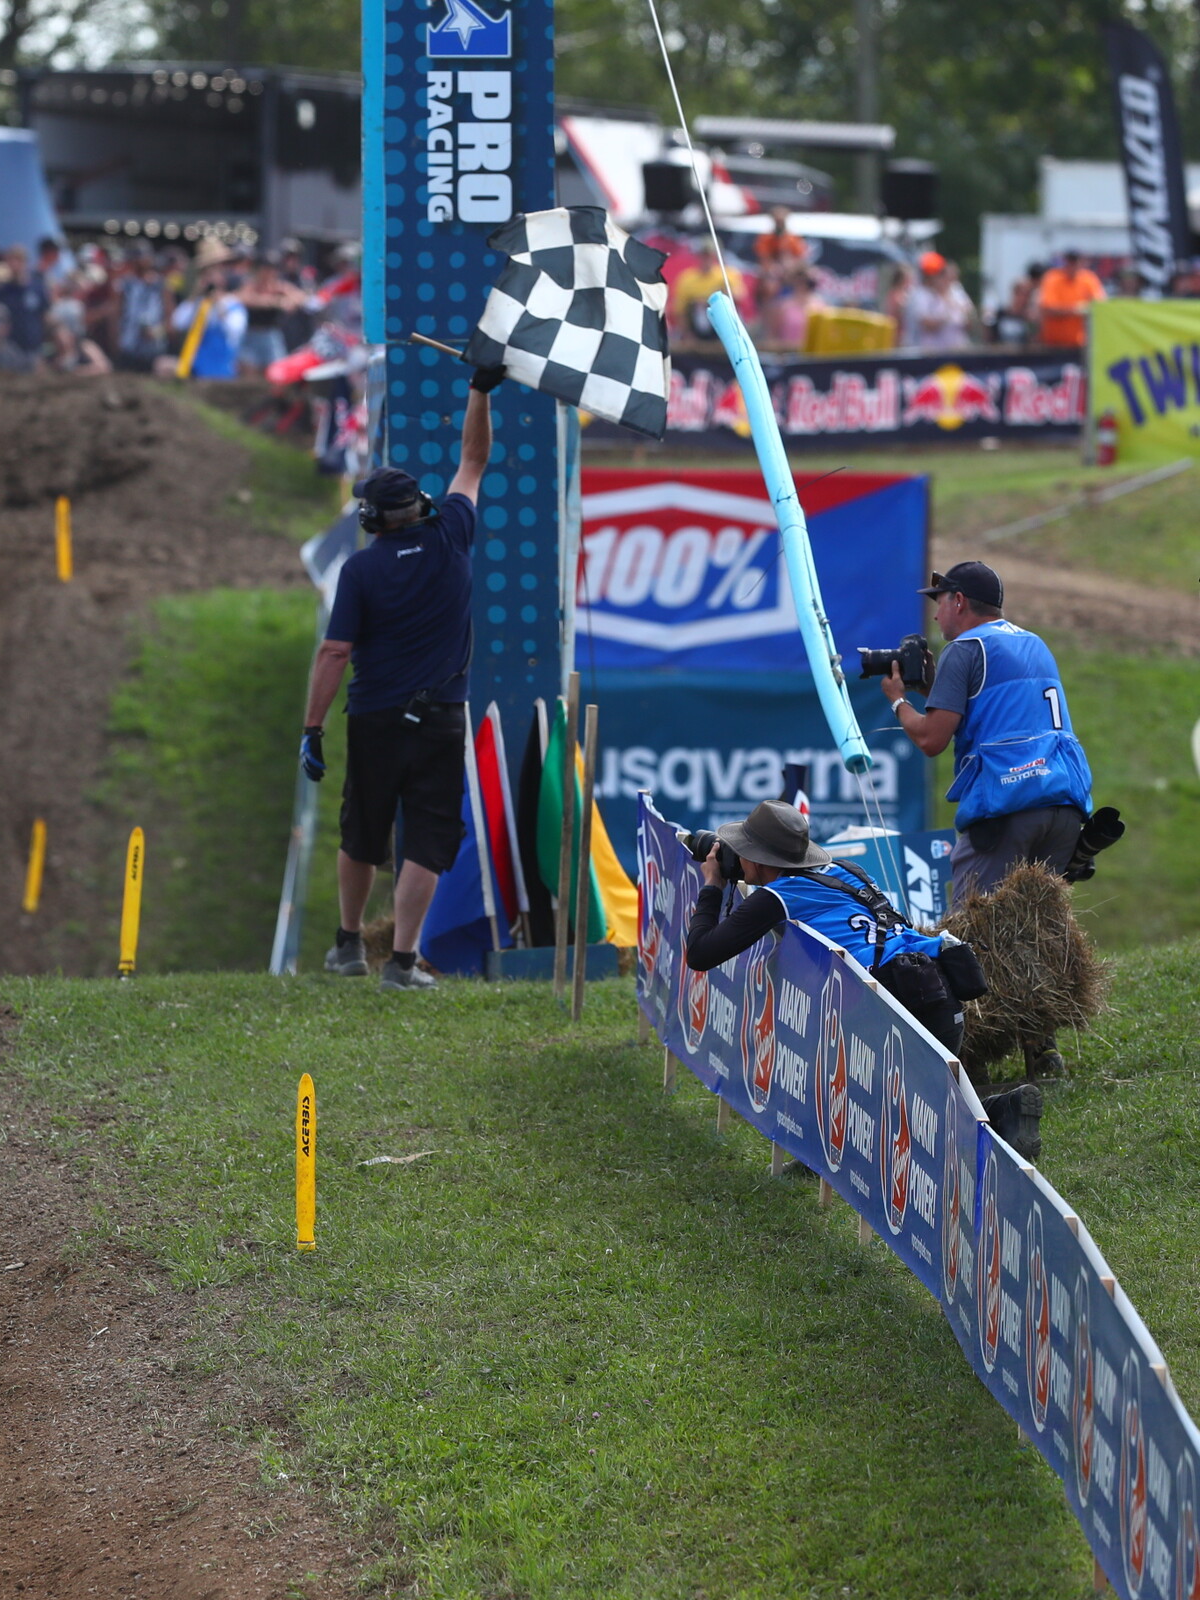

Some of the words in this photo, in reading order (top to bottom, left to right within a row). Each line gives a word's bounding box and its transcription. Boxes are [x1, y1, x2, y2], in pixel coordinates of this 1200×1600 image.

[427, 71, 453, 222] RACING
[457, 71, 513, 222] PRO
[578, 525, 768, 610] 100%
[1043, 686, 1063, 730] 1
[1000, 768, 1052, 785] MOTOCR
[932, 868, 942, 921] CING
[708, 983, 738, 1047] POWER!
[778, 977, 812, 1039] MAKIN'
[774, 1040, 809, 1106] POWER!
[850, 1032, 876, 1096] MAKIN'
[301, 1095, 310, 1158] ACERBIS
[848, 1097, 875, 1164] POWER!
[911, 1092, 938, 1159] MAKIN'
[909, 1158, 938, 1230] POWER!
[1000, 1288, 1022, 1359] POWER!
